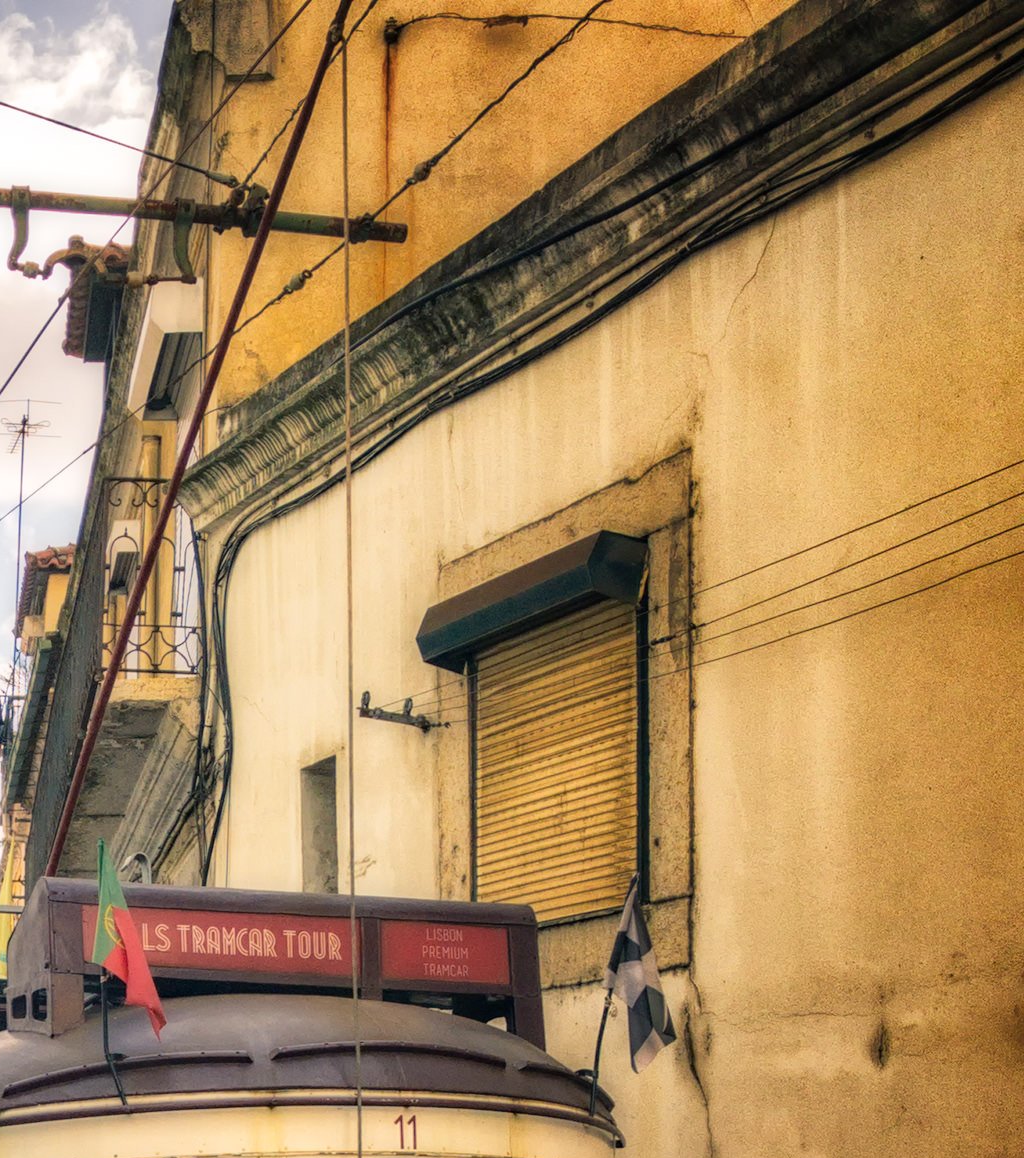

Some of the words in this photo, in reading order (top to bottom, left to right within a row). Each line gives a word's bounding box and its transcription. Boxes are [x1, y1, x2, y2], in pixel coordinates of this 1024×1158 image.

[176, 923, 278, 958] TRAMCAR
[282, 928, 343, 961] TOUR
[425, 927, 464, 942] LISBON
[421, 944, 470, 960] PREMIUM
[423, 962, 470, 978] TRAMCAR
[393, 1114, 417, 1150] 11
